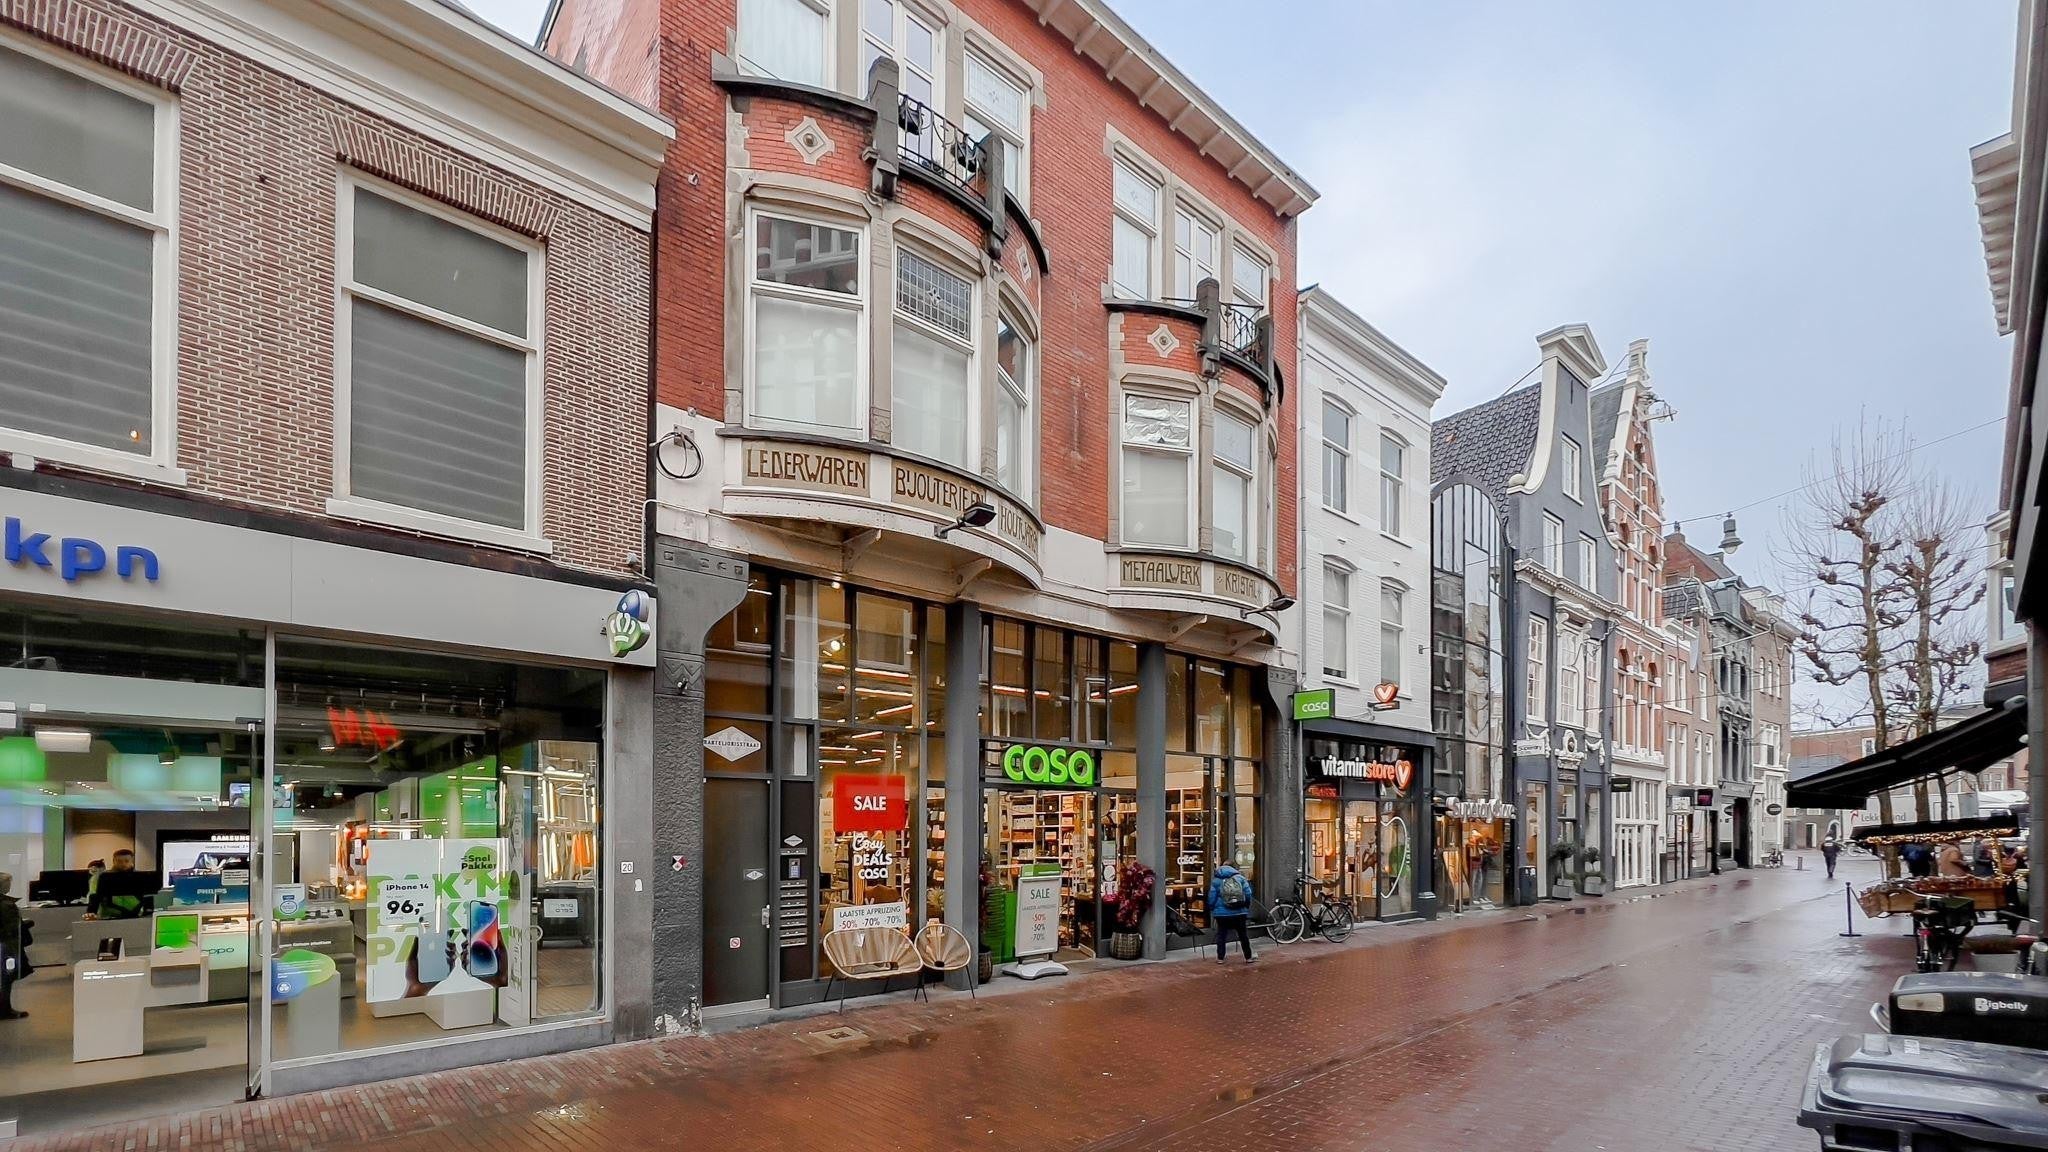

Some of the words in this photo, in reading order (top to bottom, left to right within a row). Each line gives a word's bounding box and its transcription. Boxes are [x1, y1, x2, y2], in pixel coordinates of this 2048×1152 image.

[747, 449, 866, 488] LEDERWAREN
[5, 517, 159, 580] kpn
[1122, 560, 1200, 587] METAALWERK
[1302, 701, 1329, 713] casa
[1004, 744, 1094, 785] casa
[1321, 755, 1395, 779] vitaminstore
[854, 795, 887, 811] SALE
[853, 853, 893, 866] DEALS
[622, 863, 633, 872] 20
[858, 866, 889, 880] casa
[386, 883, 418, 891] iPhone
[1030, 888, 1050, 900] SALE
[839, 909, 865, 918] LAATSTE
[839, 920, 858, 929] -50%
[862, 917, 880, 926] -70%
[1974, 997, 2029, 1012] Bigbelly
